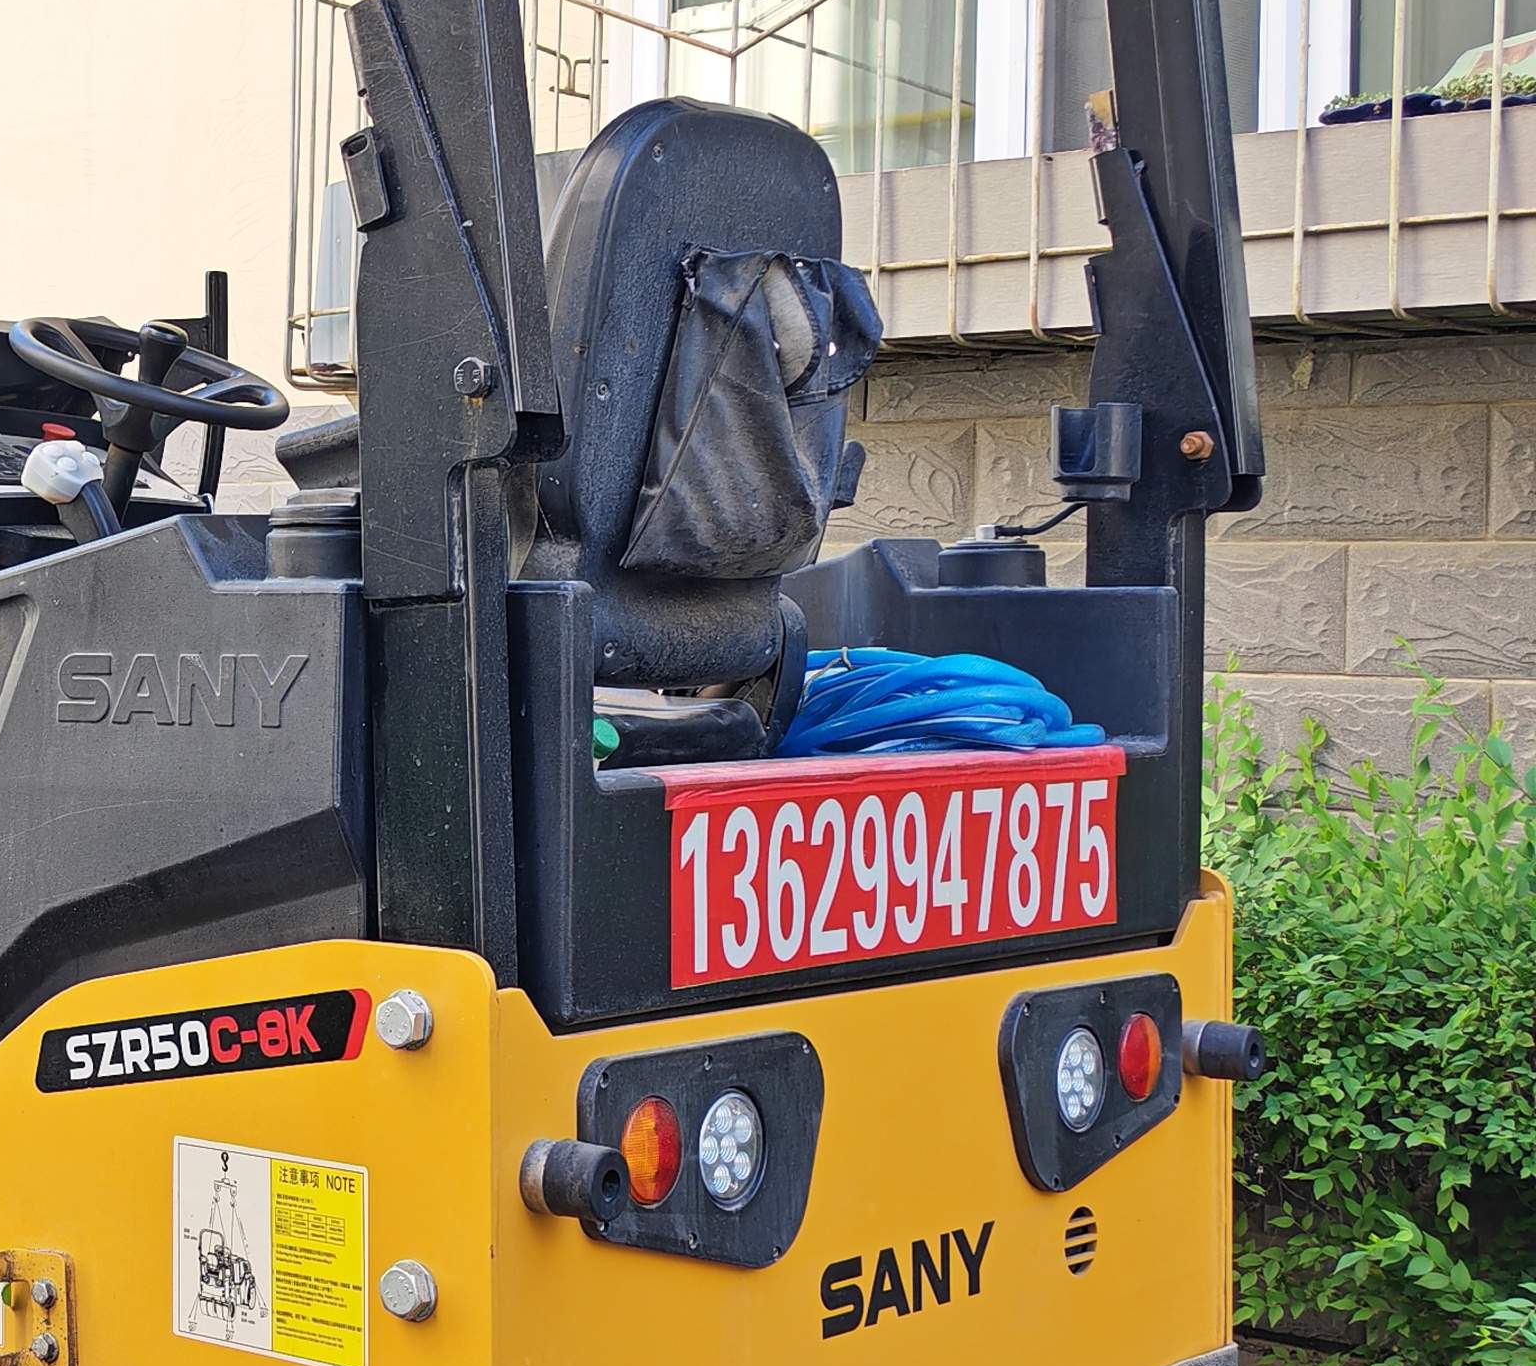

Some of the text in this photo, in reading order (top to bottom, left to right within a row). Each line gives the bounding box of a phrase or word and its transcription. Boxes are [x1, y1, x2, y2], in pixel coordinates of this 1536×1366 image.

[56, 652, 309, 728] SANY
[679, 779, 1110, 974] 13629947875
[65, 1003, 322, 1081] SZR50C-8K
[279, 1166, 356, 1194] 注意事项 NOTE
[820, 1221, 995, 1340] SANY
